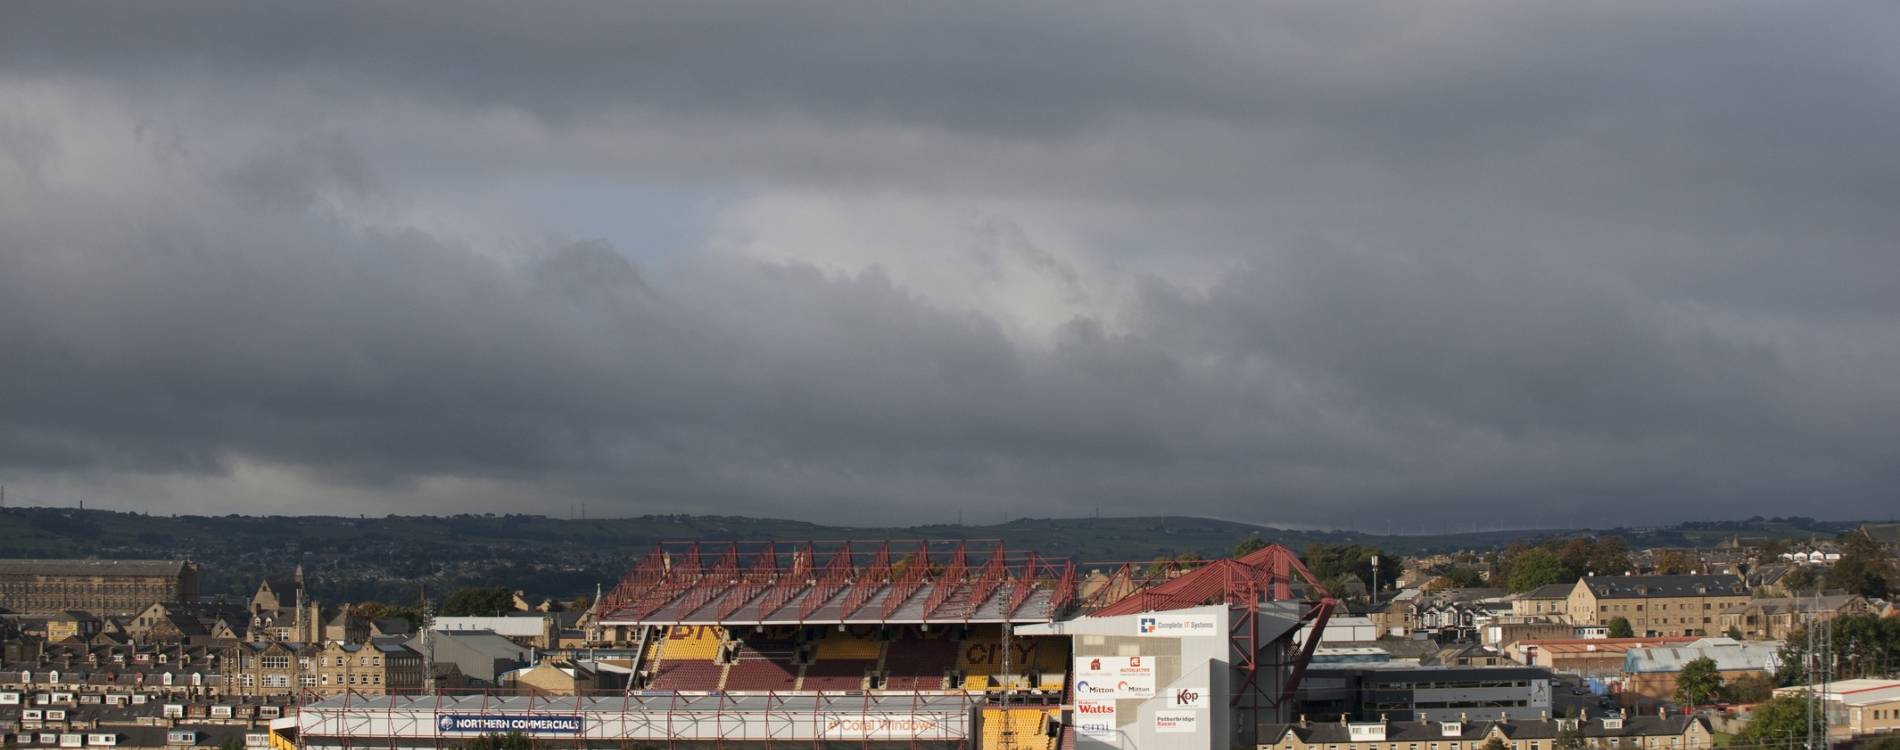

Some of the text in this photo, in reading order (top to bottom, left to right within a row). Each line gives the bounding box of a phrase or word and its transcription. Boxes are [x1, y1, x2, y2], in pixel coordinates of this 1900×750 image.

[1158, 621, 1182, 629] Complete
[1191, 621, 1213, 629] Systems
[967, 643, 1036, 664] CITY
[1177, 689, 1198, 704] Kop
[1078, 705, 1114, 713] Watts
[456, 719, 579, 729] NORTHERN COMMERCIALS
[842, 720, 937, 730] Coral Windows
